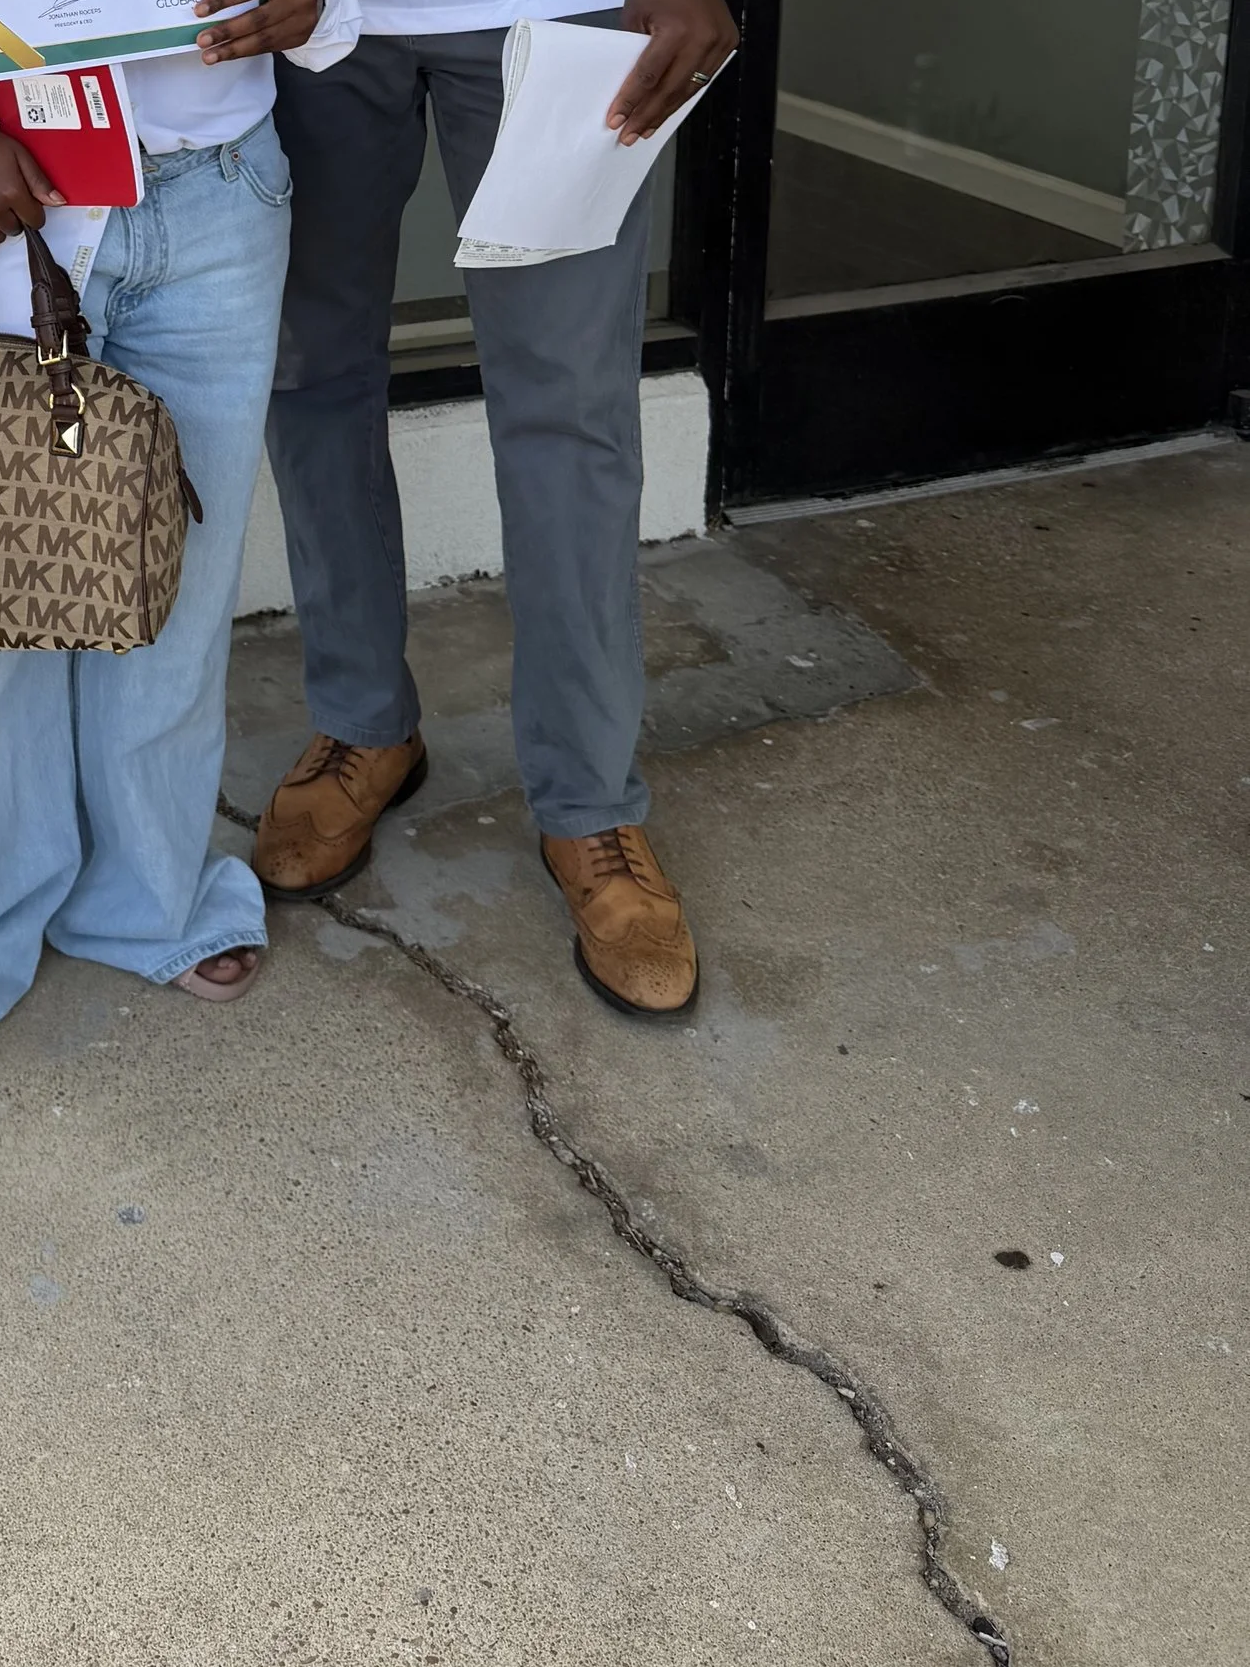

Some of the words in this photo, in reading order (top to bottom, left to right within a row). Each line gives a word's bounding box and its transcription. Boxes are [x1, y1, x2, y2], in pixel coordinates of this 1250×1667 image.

[91, 366, 142, 396] MK
[47, 454, 93, 490] MK
[96, 462, 145, 500] MK
[14, 486, 66, 521] MK
[70, 493, 113, 532] MK
[37, 524, 87, 560] MK
[92, 533, 135, 571] MK
[3, 558, 56, 593] MK
[60, 563, 108, 601] MK
[26, 596, 79, 633] MK
[83, 604, 133, 640] MK
